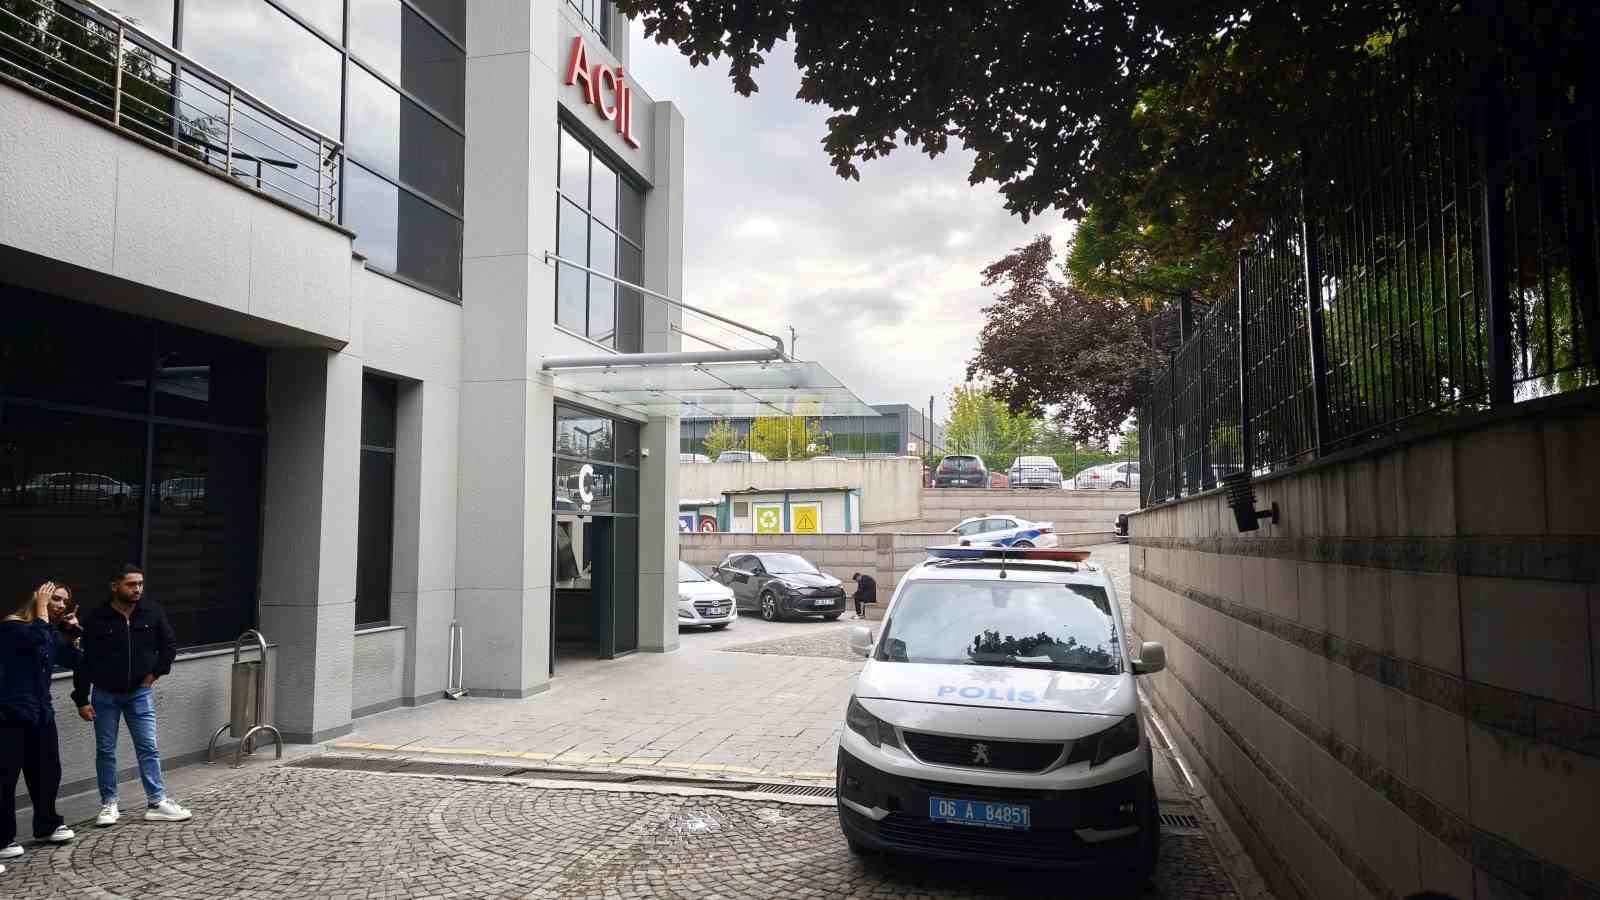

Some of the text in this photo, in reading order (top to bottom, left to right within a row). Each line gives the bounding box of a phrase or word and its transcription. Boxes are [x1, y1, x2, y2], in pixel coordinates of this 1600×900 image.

[939, 801, 957, 817] 06
[965, 802, 974, 819] A
[985, 805, 1028, 825] 84851
